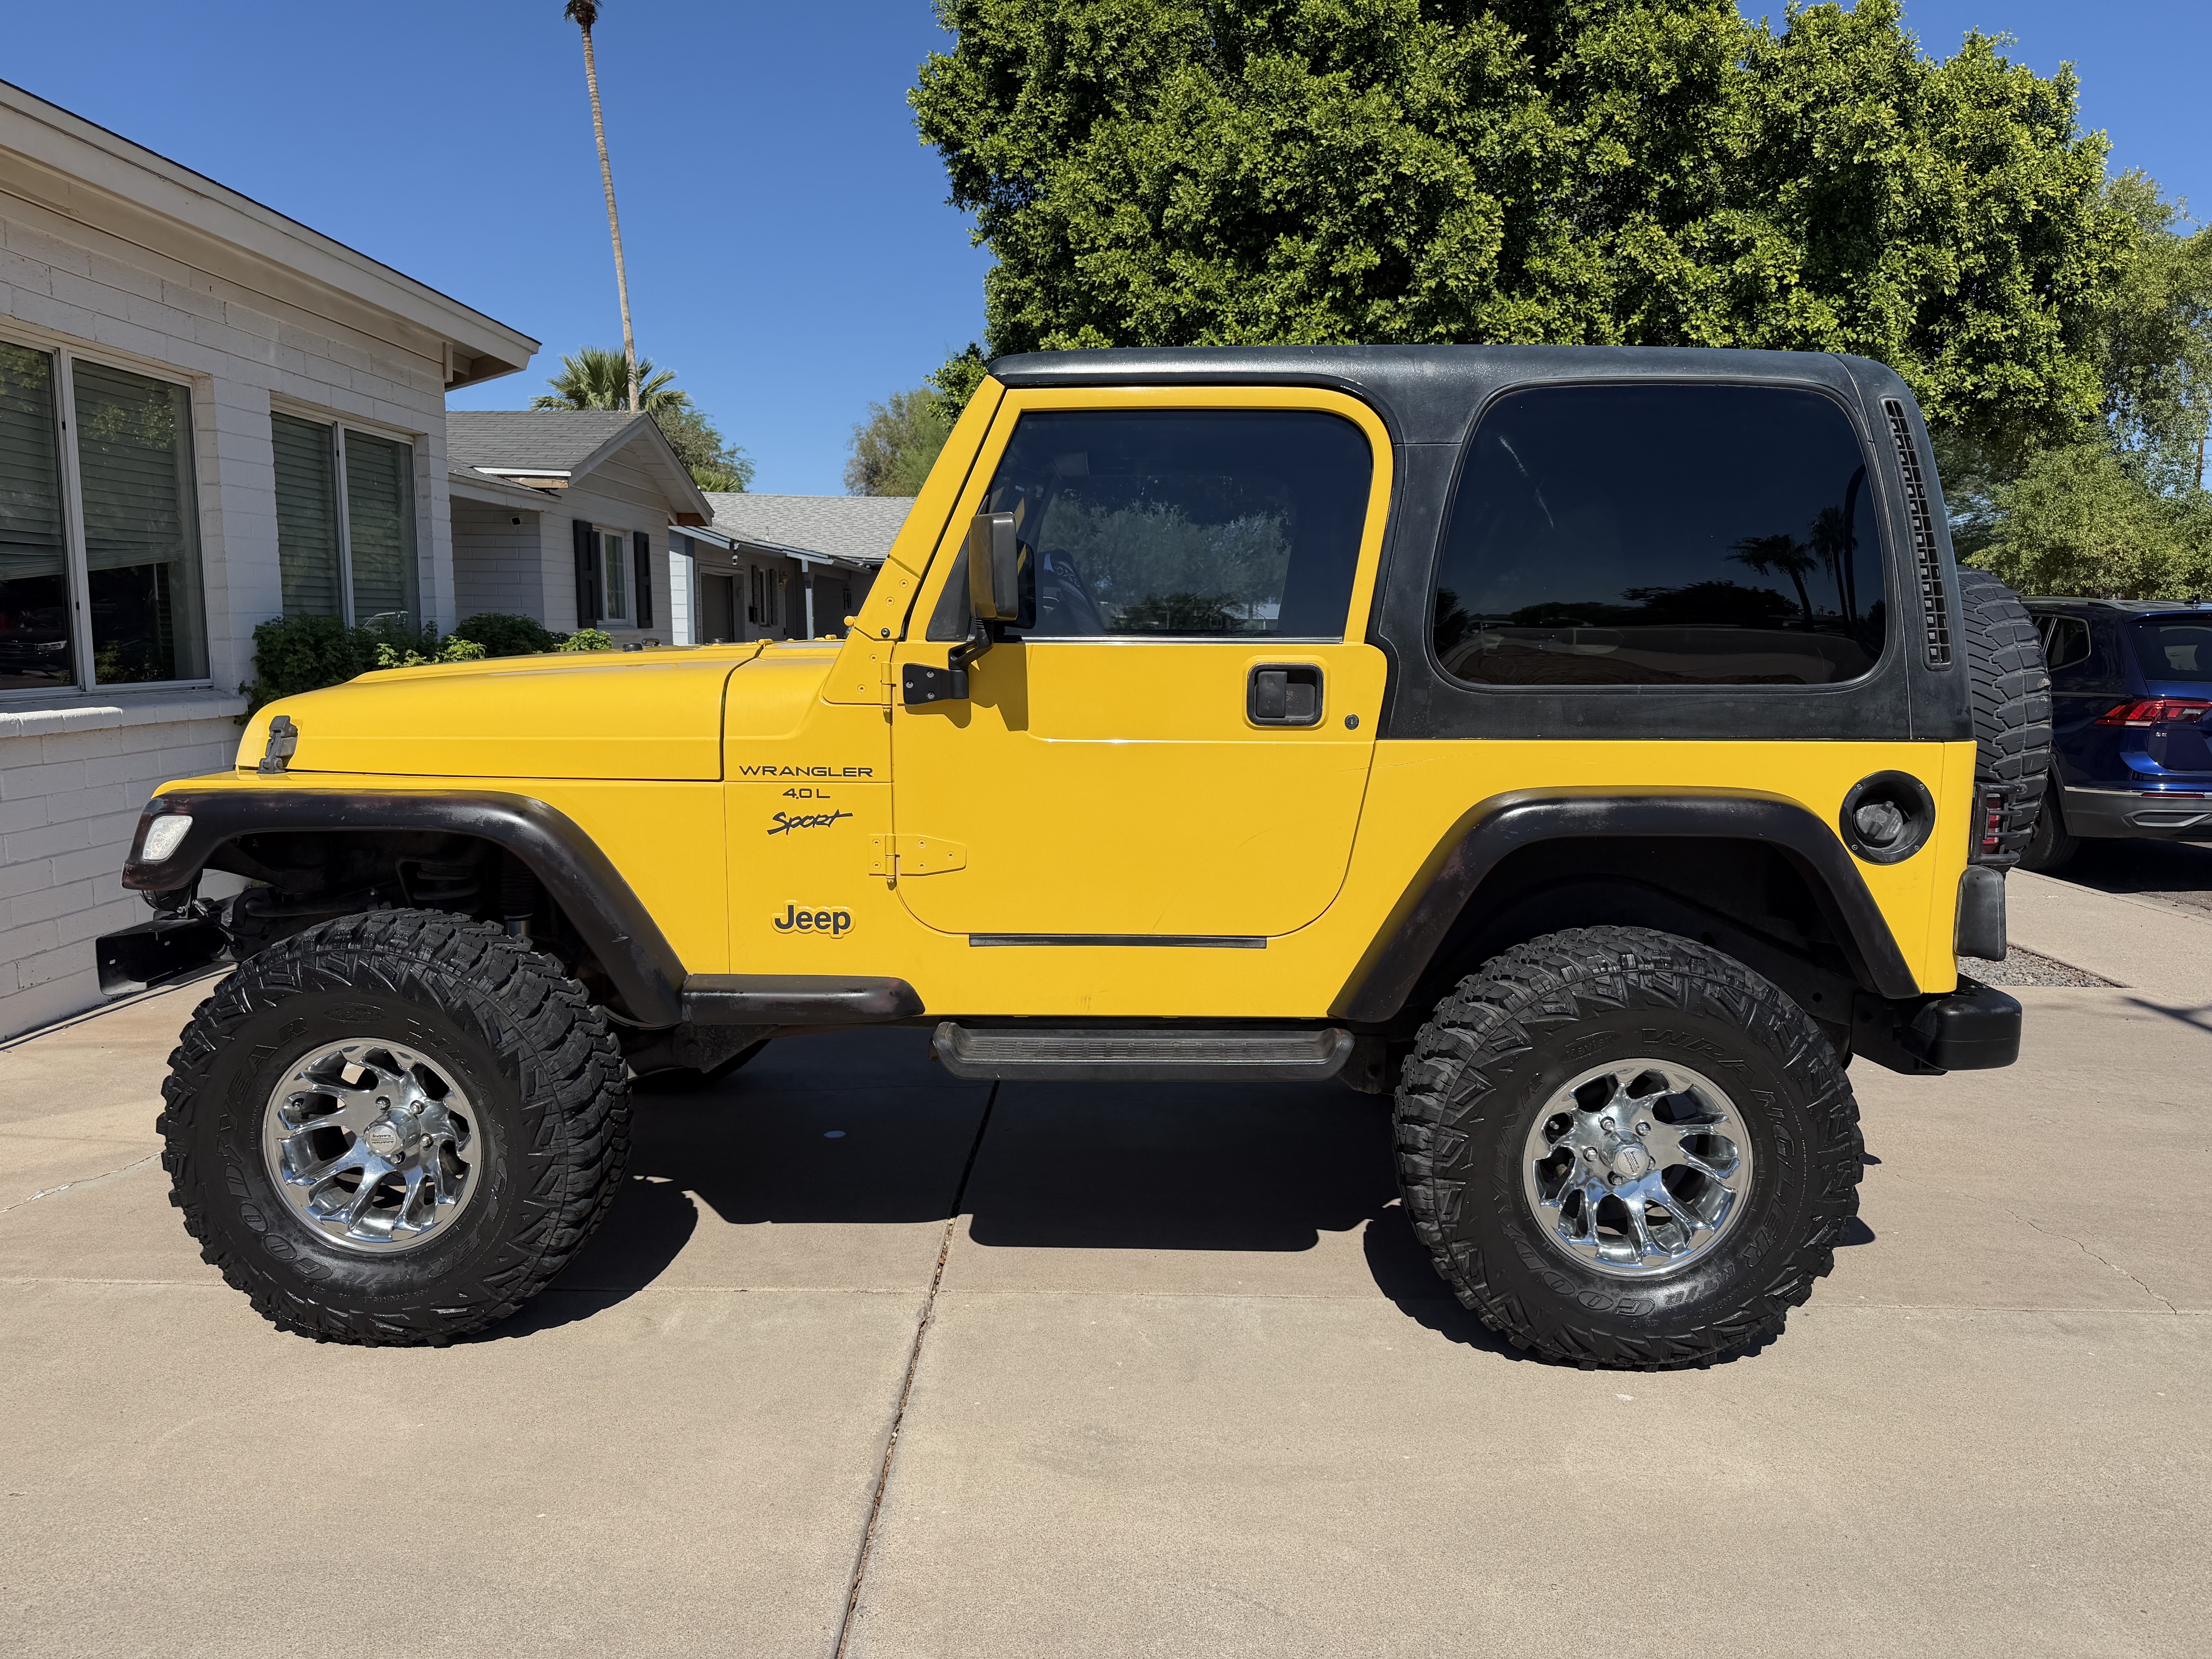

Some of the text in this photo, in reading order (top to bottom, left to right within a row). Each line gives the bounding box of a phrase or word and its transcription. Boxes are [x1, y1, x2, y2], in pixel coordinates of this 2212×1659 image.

[739, 766, 873, 777] WRANGLER
[775, 905, 851, 934] Jeep
[218, 1016, 333, 1280] GOODYEAR
[407, 1018, 509, 1280] WRANGLER
[1492, 1071, 1655, 1317] GOODYEAR
[1642, 1028, 1795, 1269] WRANGLER
